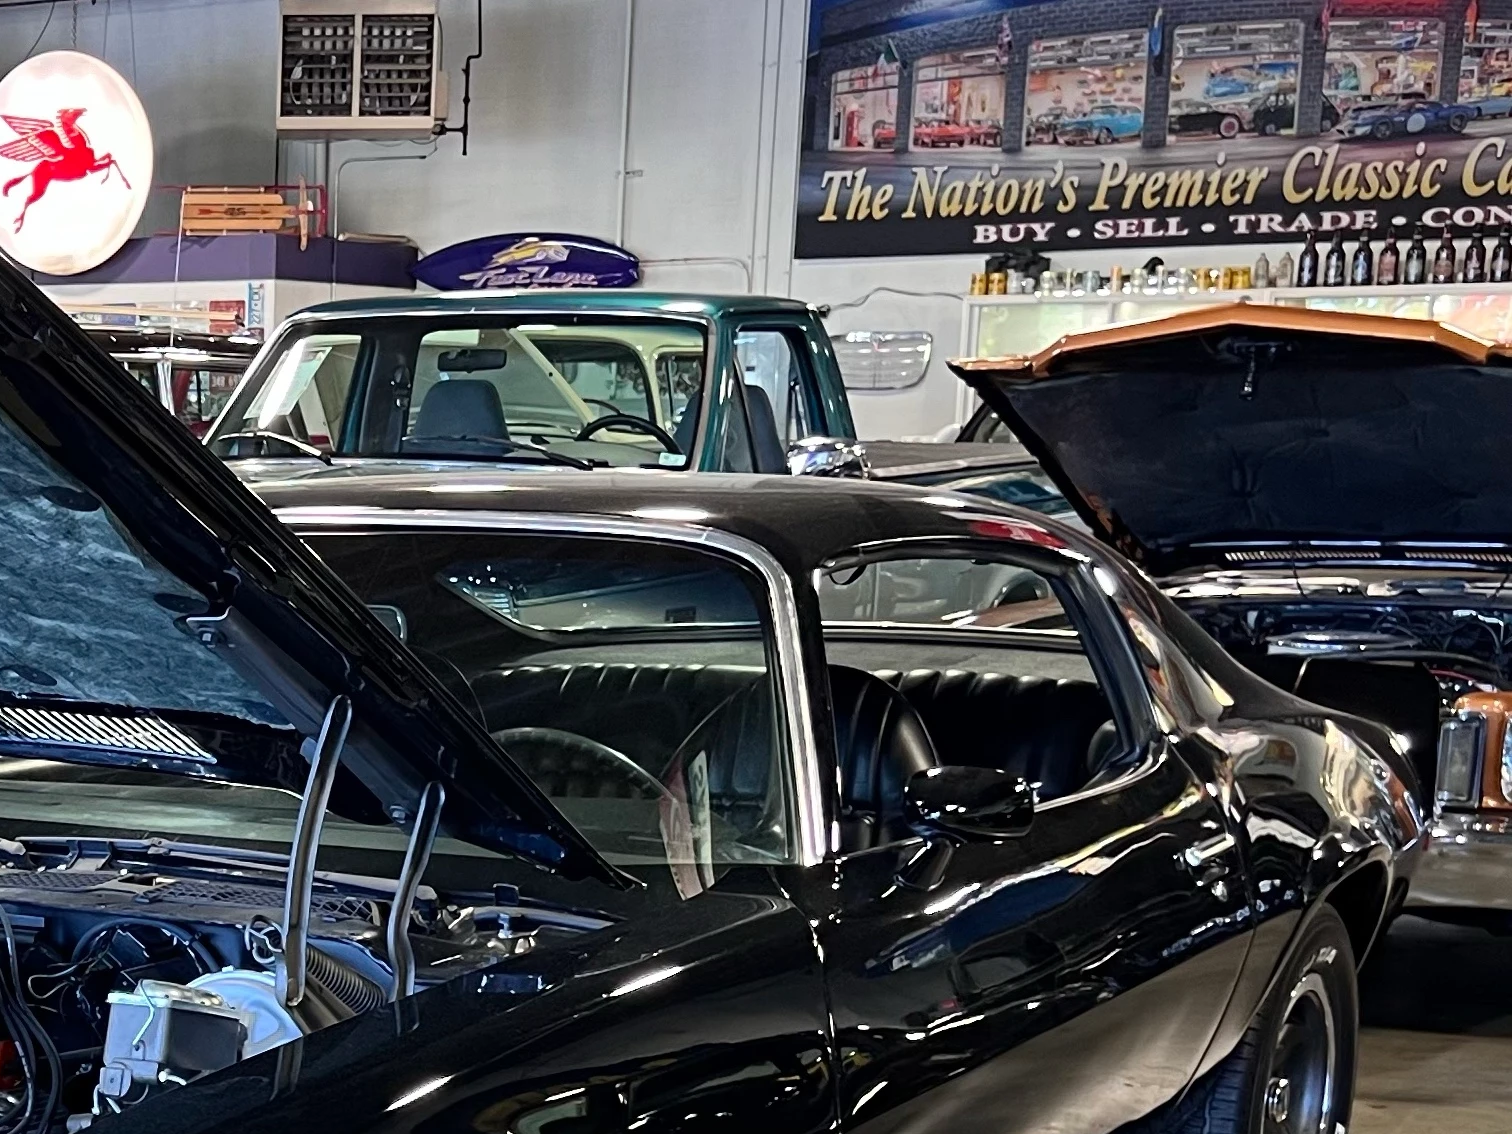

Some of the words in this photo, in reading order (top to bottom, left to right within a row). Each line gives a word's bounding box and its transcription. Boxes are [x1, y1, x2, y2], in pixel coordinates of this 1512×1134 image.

[817, 167, 894, 222] The
[901, 159, 1079, 219] Nation's
[1088, 152, 1269, 212] Premier
[1282, 141, 1448, 204] Classic
[973, 222, 1056, 244] BUY
[1093, 217, 1190, 240] SELL
[1229, 210, 1378, 235] TRADE
